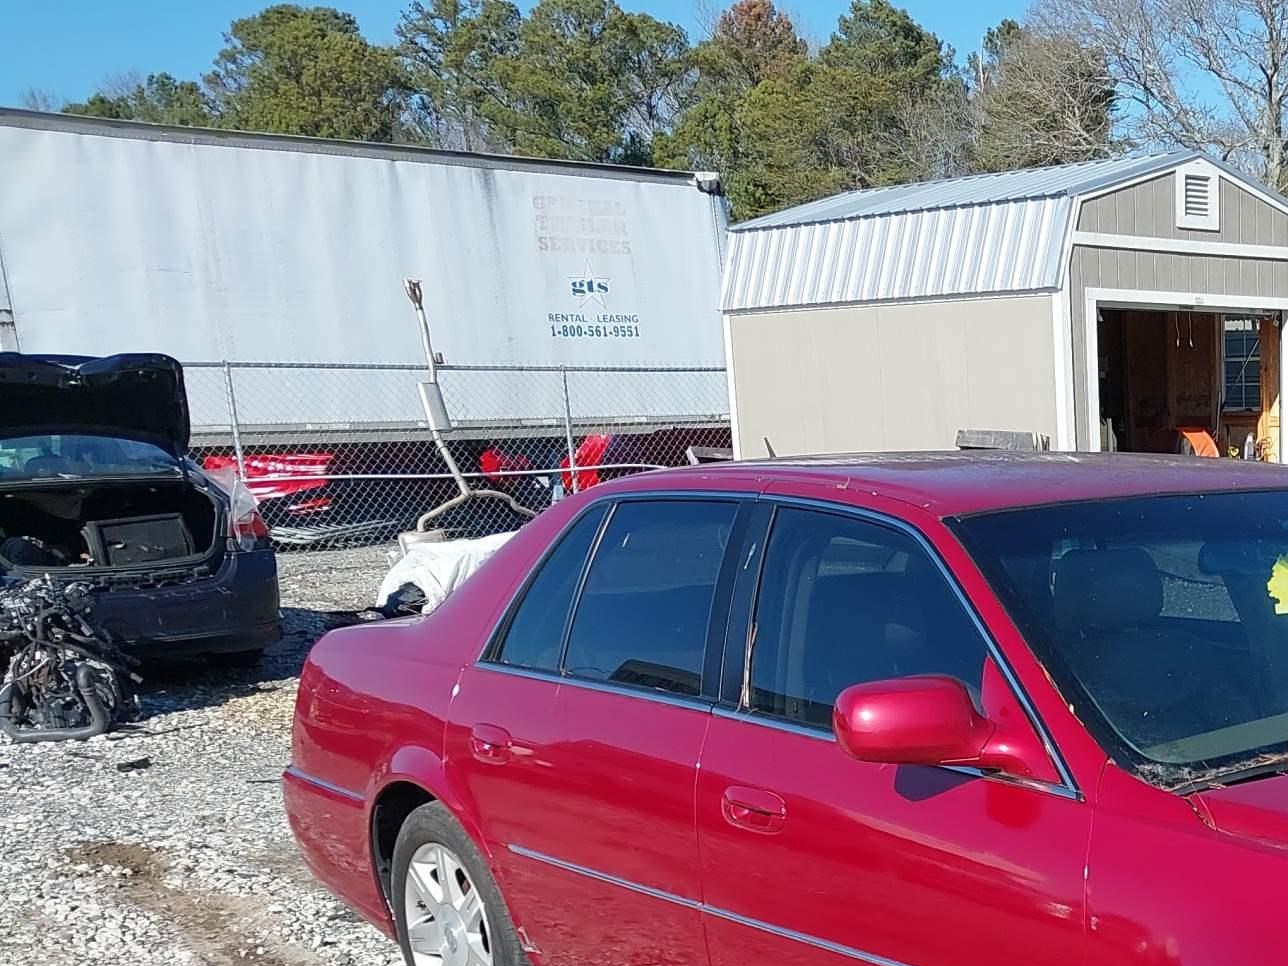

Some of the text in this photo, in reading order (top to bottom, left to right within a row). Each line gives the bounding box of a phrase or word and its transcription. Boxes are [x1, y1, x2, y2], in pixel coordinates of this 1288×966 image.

[571, 278, 609, 296] gts
[548, 313, 639, 323] RENTAL LEASING
[551, 324, 640, 337] 1-800-561-9551
